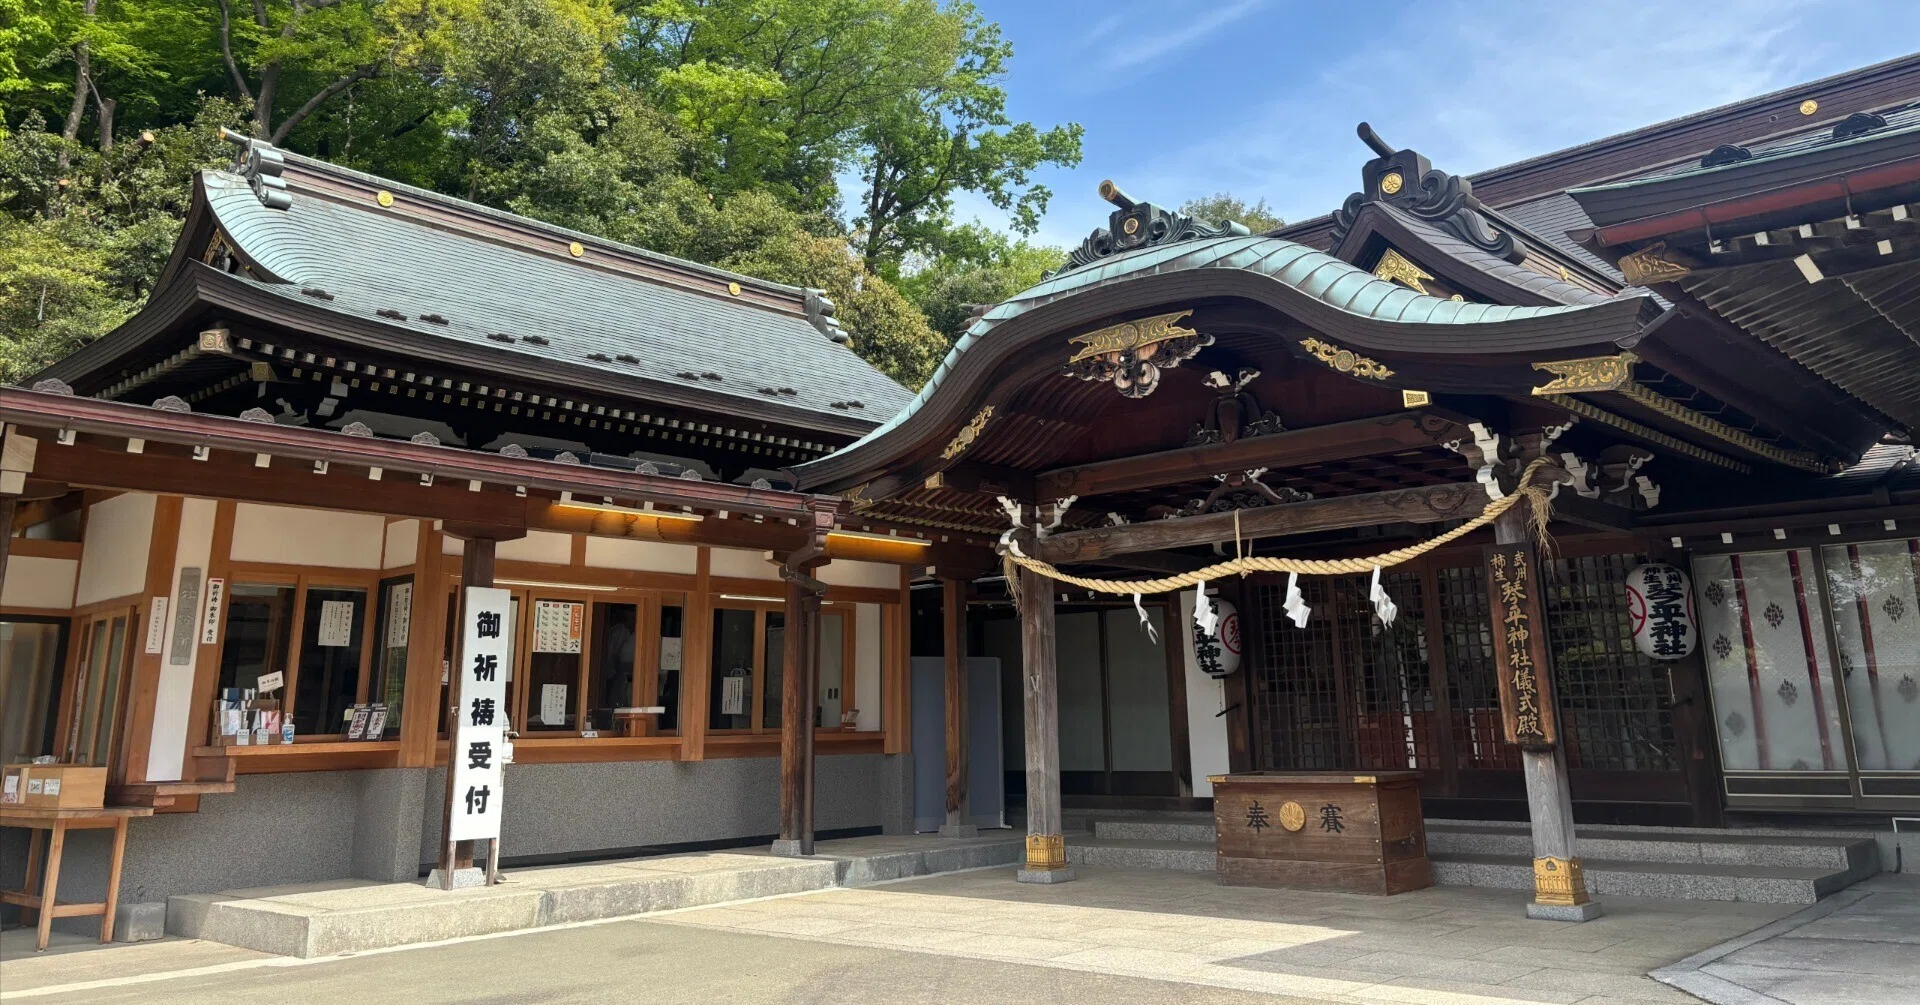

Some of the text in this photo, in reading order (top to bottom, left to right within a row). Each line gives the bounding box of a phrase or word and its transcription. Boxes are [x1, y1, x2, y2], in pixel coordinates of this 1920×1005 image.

[1490, 552, 1507, 582] 柿生
[1513, 550, 1527, 581] 武州
[206, 629, 214, 642] 受付
[1645, 583, 1688, 655] 琴平神社
[1501, 581, 1544, 736] 琴平神社儀式殿
[465, 611, 501, 815] 御祈祷受付
[1246, 800, 1345, 833] 奉 賽
